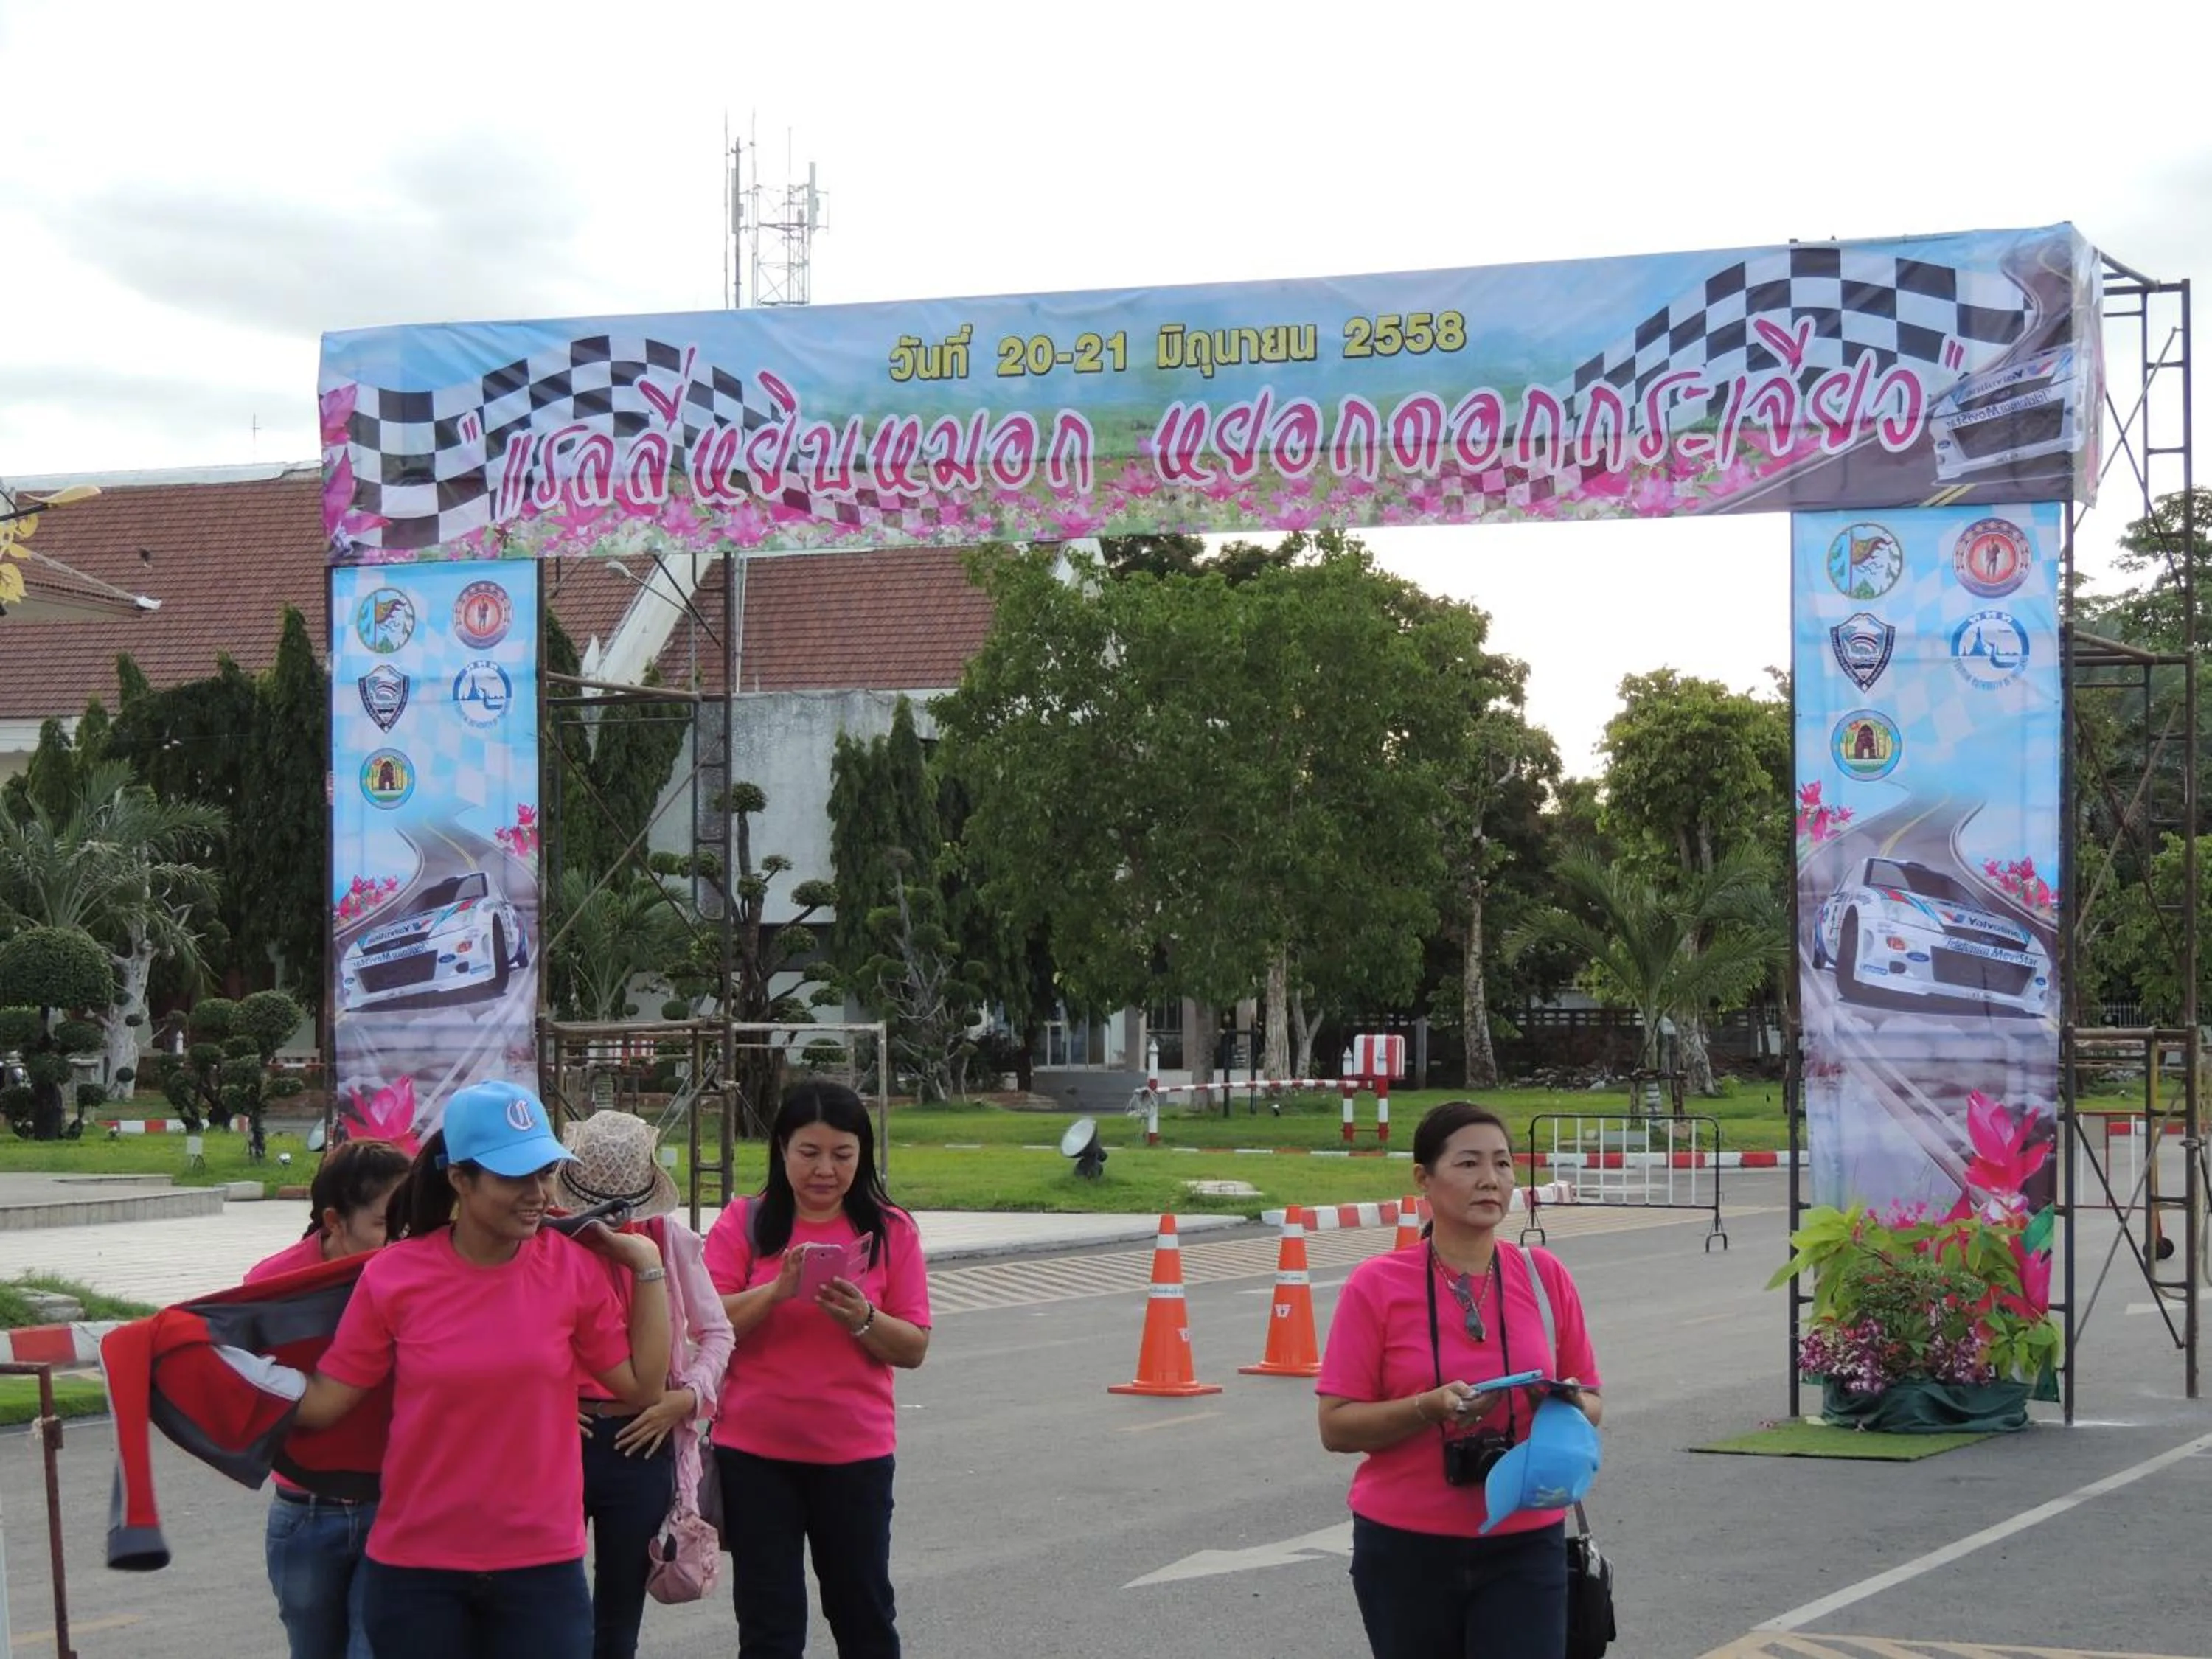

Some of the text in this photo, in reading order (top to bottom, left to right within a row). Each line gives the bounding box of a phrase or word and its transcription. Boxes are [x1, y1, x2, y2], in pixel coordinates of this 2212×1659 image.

[889, 310, 1467, 382] วันที่ 20-21 มิถุนายน 2558
